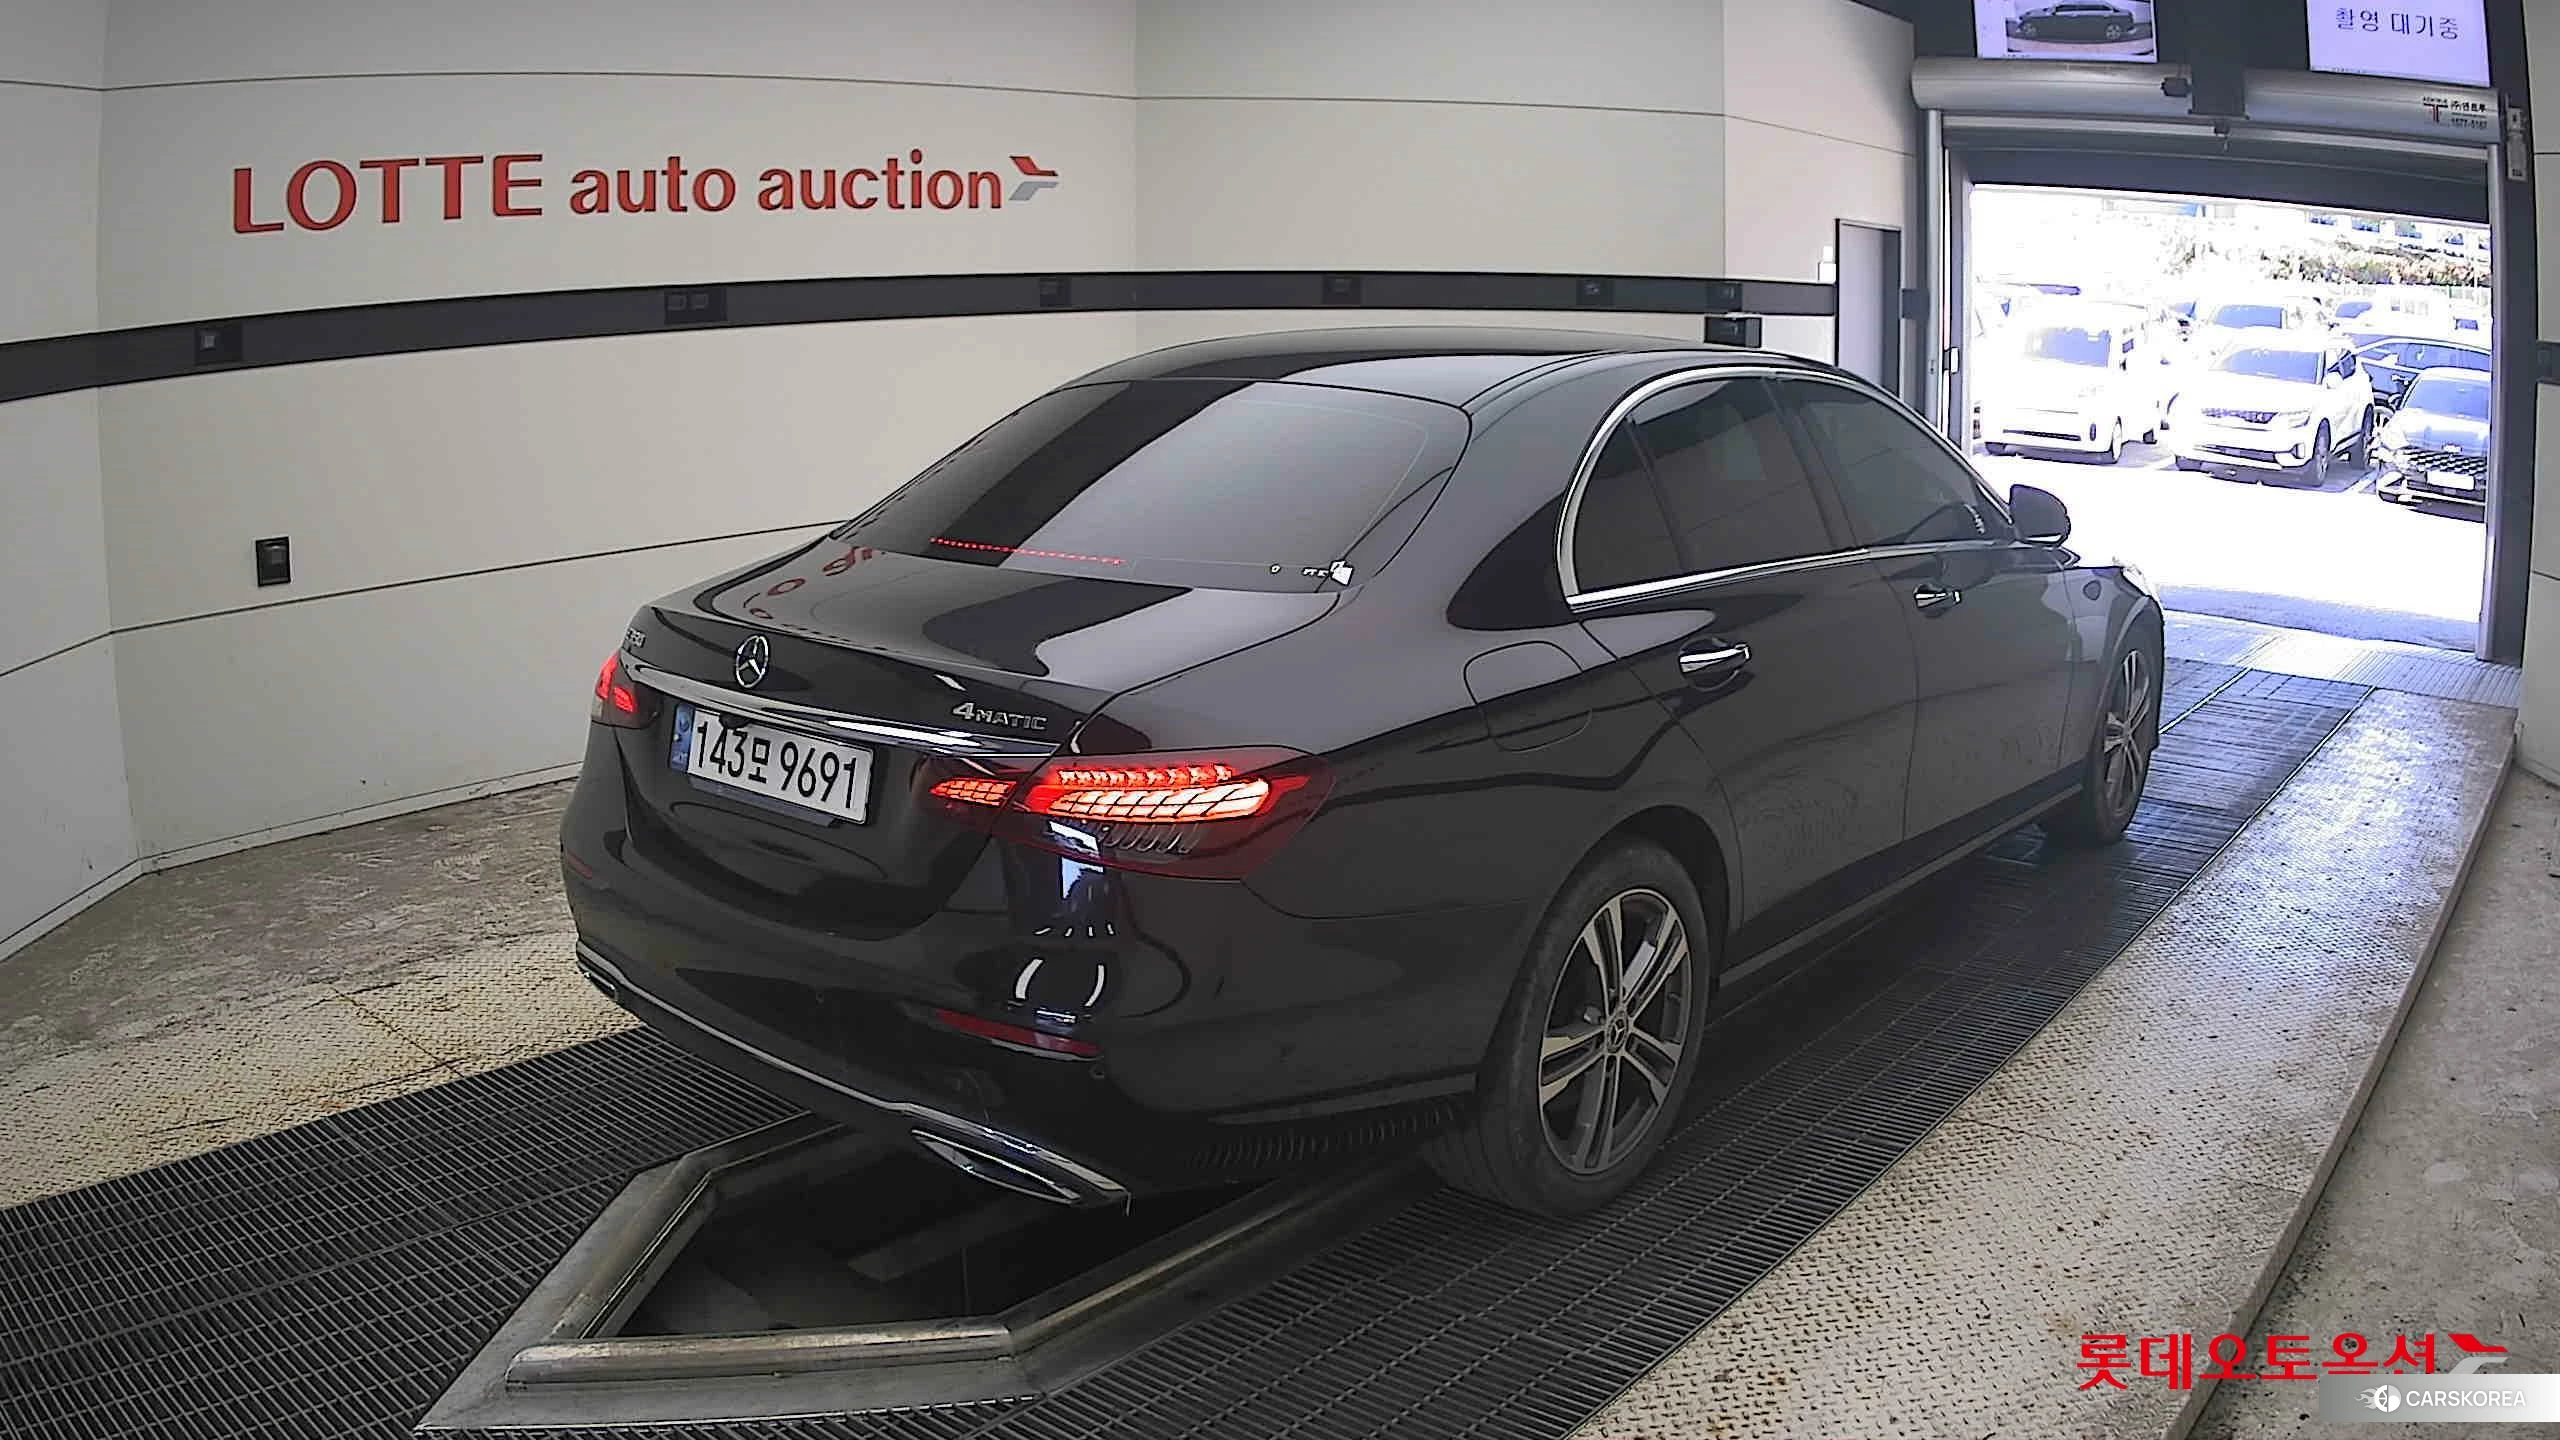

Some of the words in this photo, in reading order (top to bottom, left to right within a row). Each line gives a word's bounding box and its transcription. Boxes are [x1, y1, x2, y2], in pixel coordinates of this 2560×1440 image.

[2335, 7, 2379, 32] 촬영
[2390, 12, 2459, 40] 대기중
[234, 153, 543, 233] LOTTE
[570, 157, 737, 214] auto
[757, 148, 1004, 212] auction
[952, 702, 1048, 730] 4MATIC
